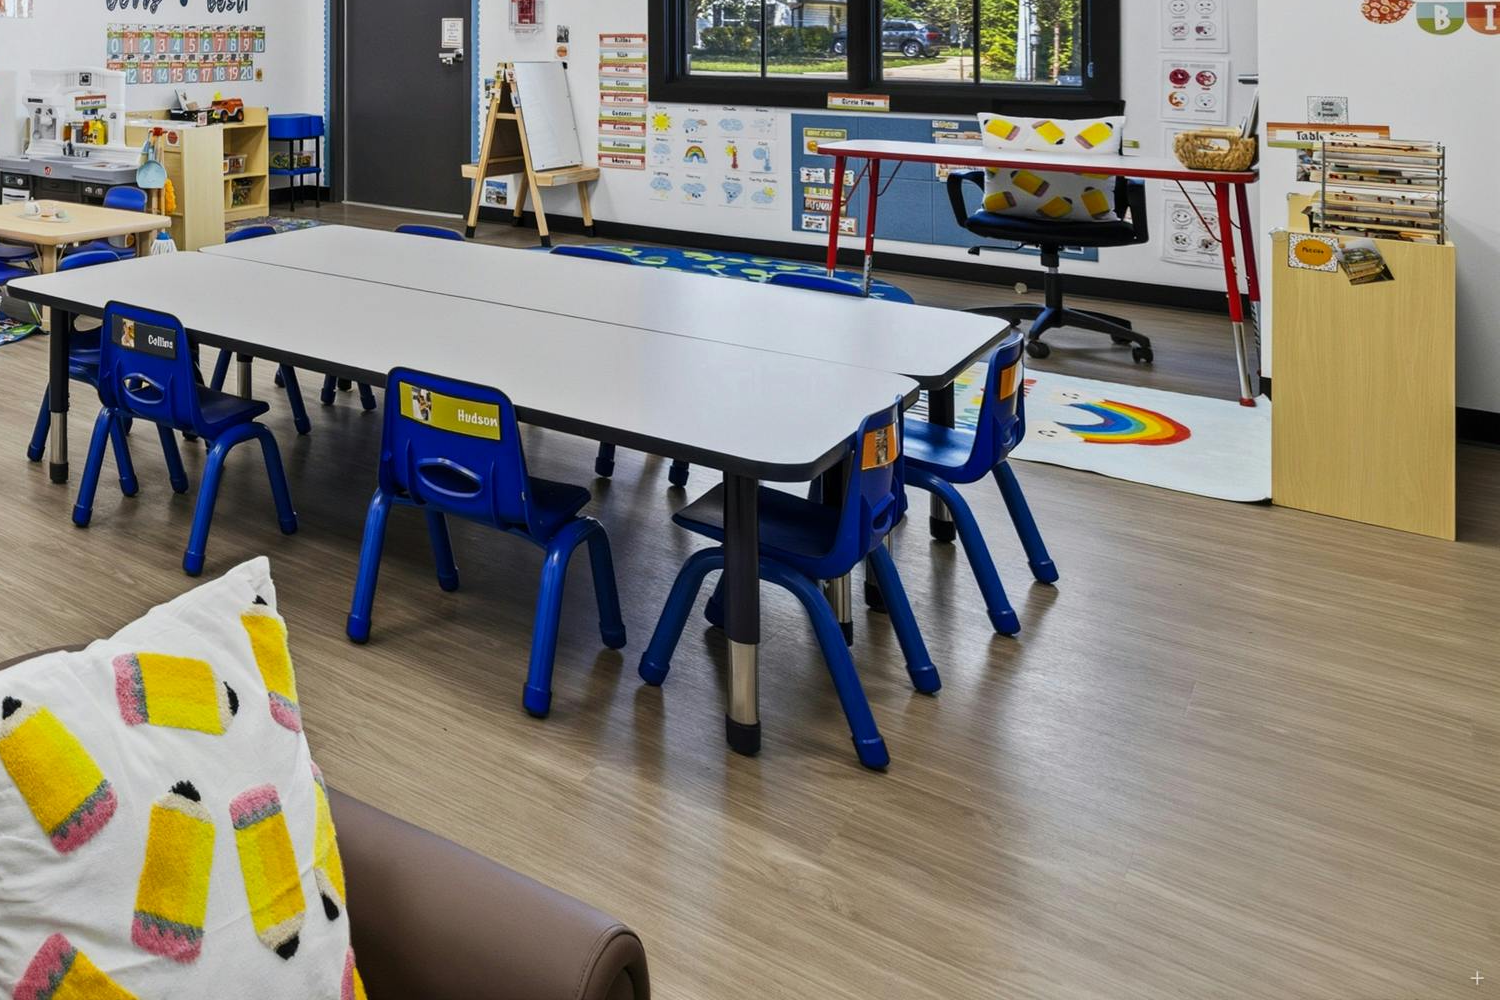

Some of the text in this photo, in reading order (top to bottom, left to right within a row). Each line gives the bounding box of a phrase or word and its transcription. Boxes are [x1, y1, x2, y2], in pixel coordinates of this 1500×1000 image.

[111, 38, 264, 53] 0 1 2 3 4 5 6 7 8 9 10
[127, 66, 252, 83] 12 13 14 15 16 17 18 19 20
[147, 334, 174, 350] Collins
[457, 409, 499, 427] Hudson
